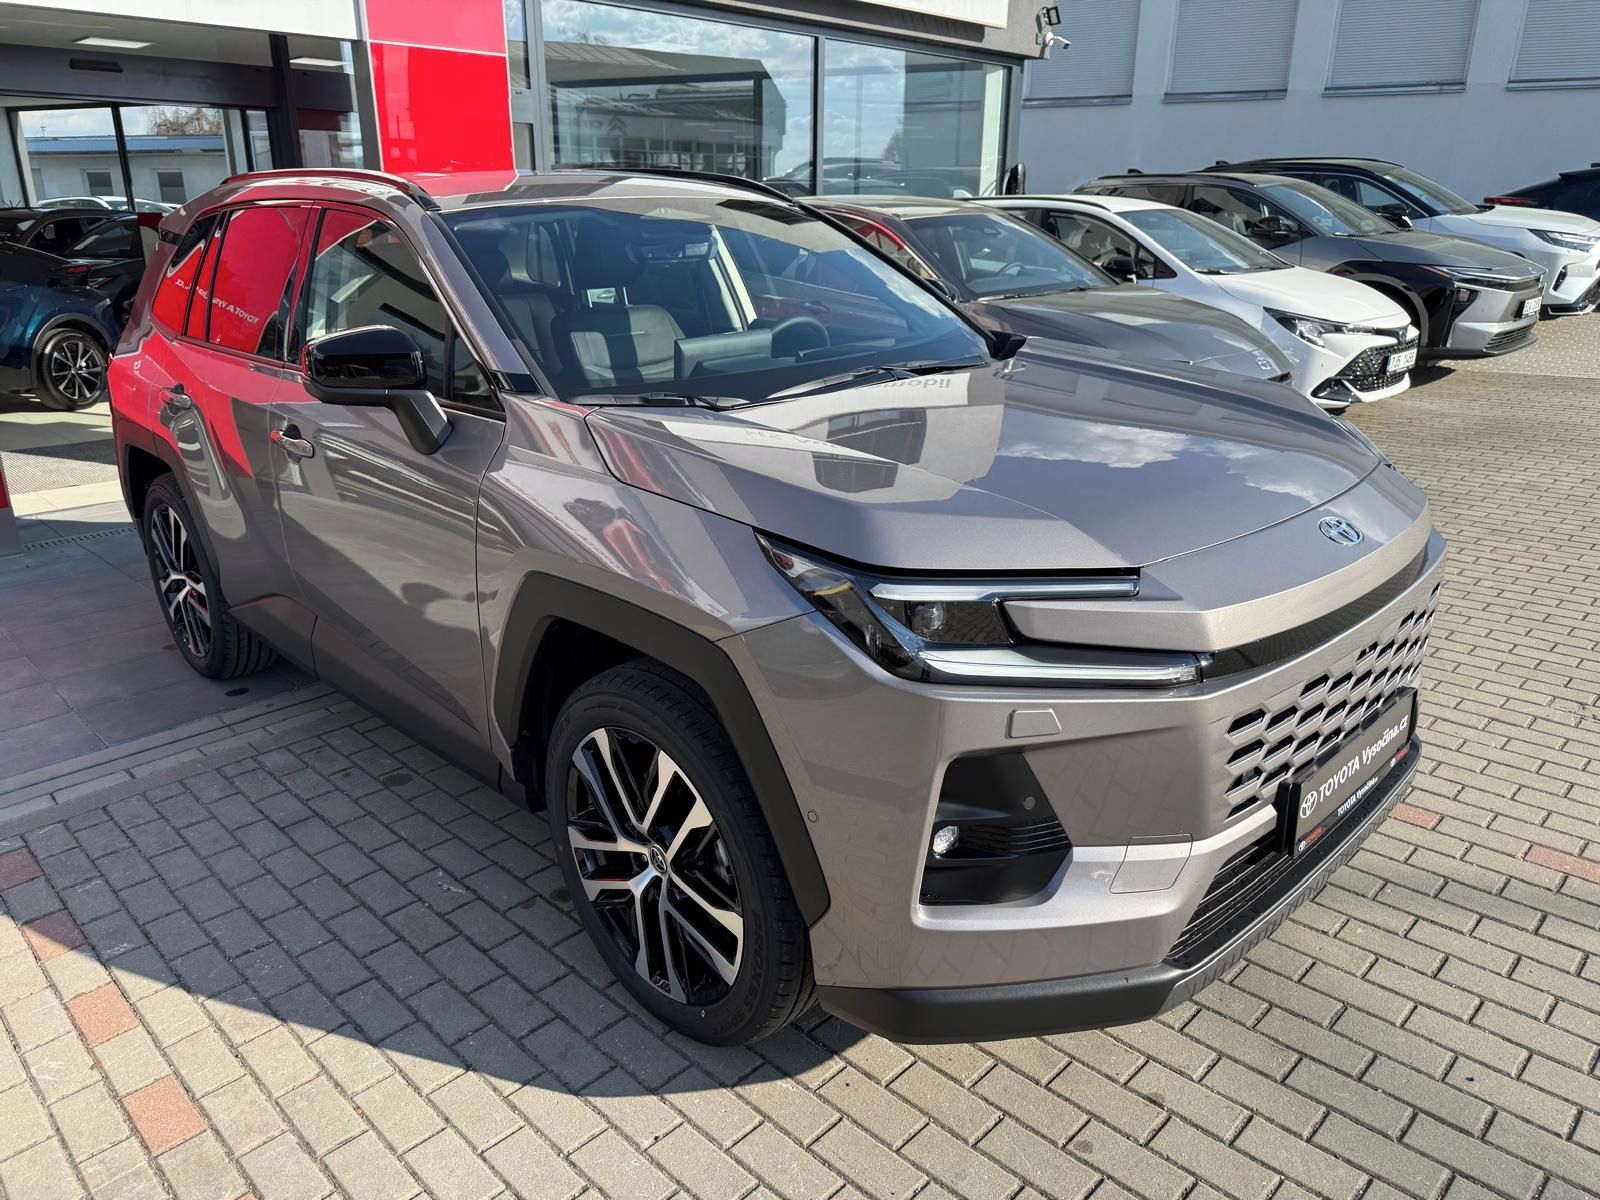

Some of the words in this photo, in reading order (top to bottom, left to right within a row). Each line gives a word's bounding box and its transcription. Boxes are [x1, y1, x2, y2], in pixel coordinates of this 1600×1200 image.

[1319, 755, 1360, 802] TOYOTA
[1362, 714, 1409, 765] Vysočina.cz
[1337, 793, 1357, 817] TOYOTA
